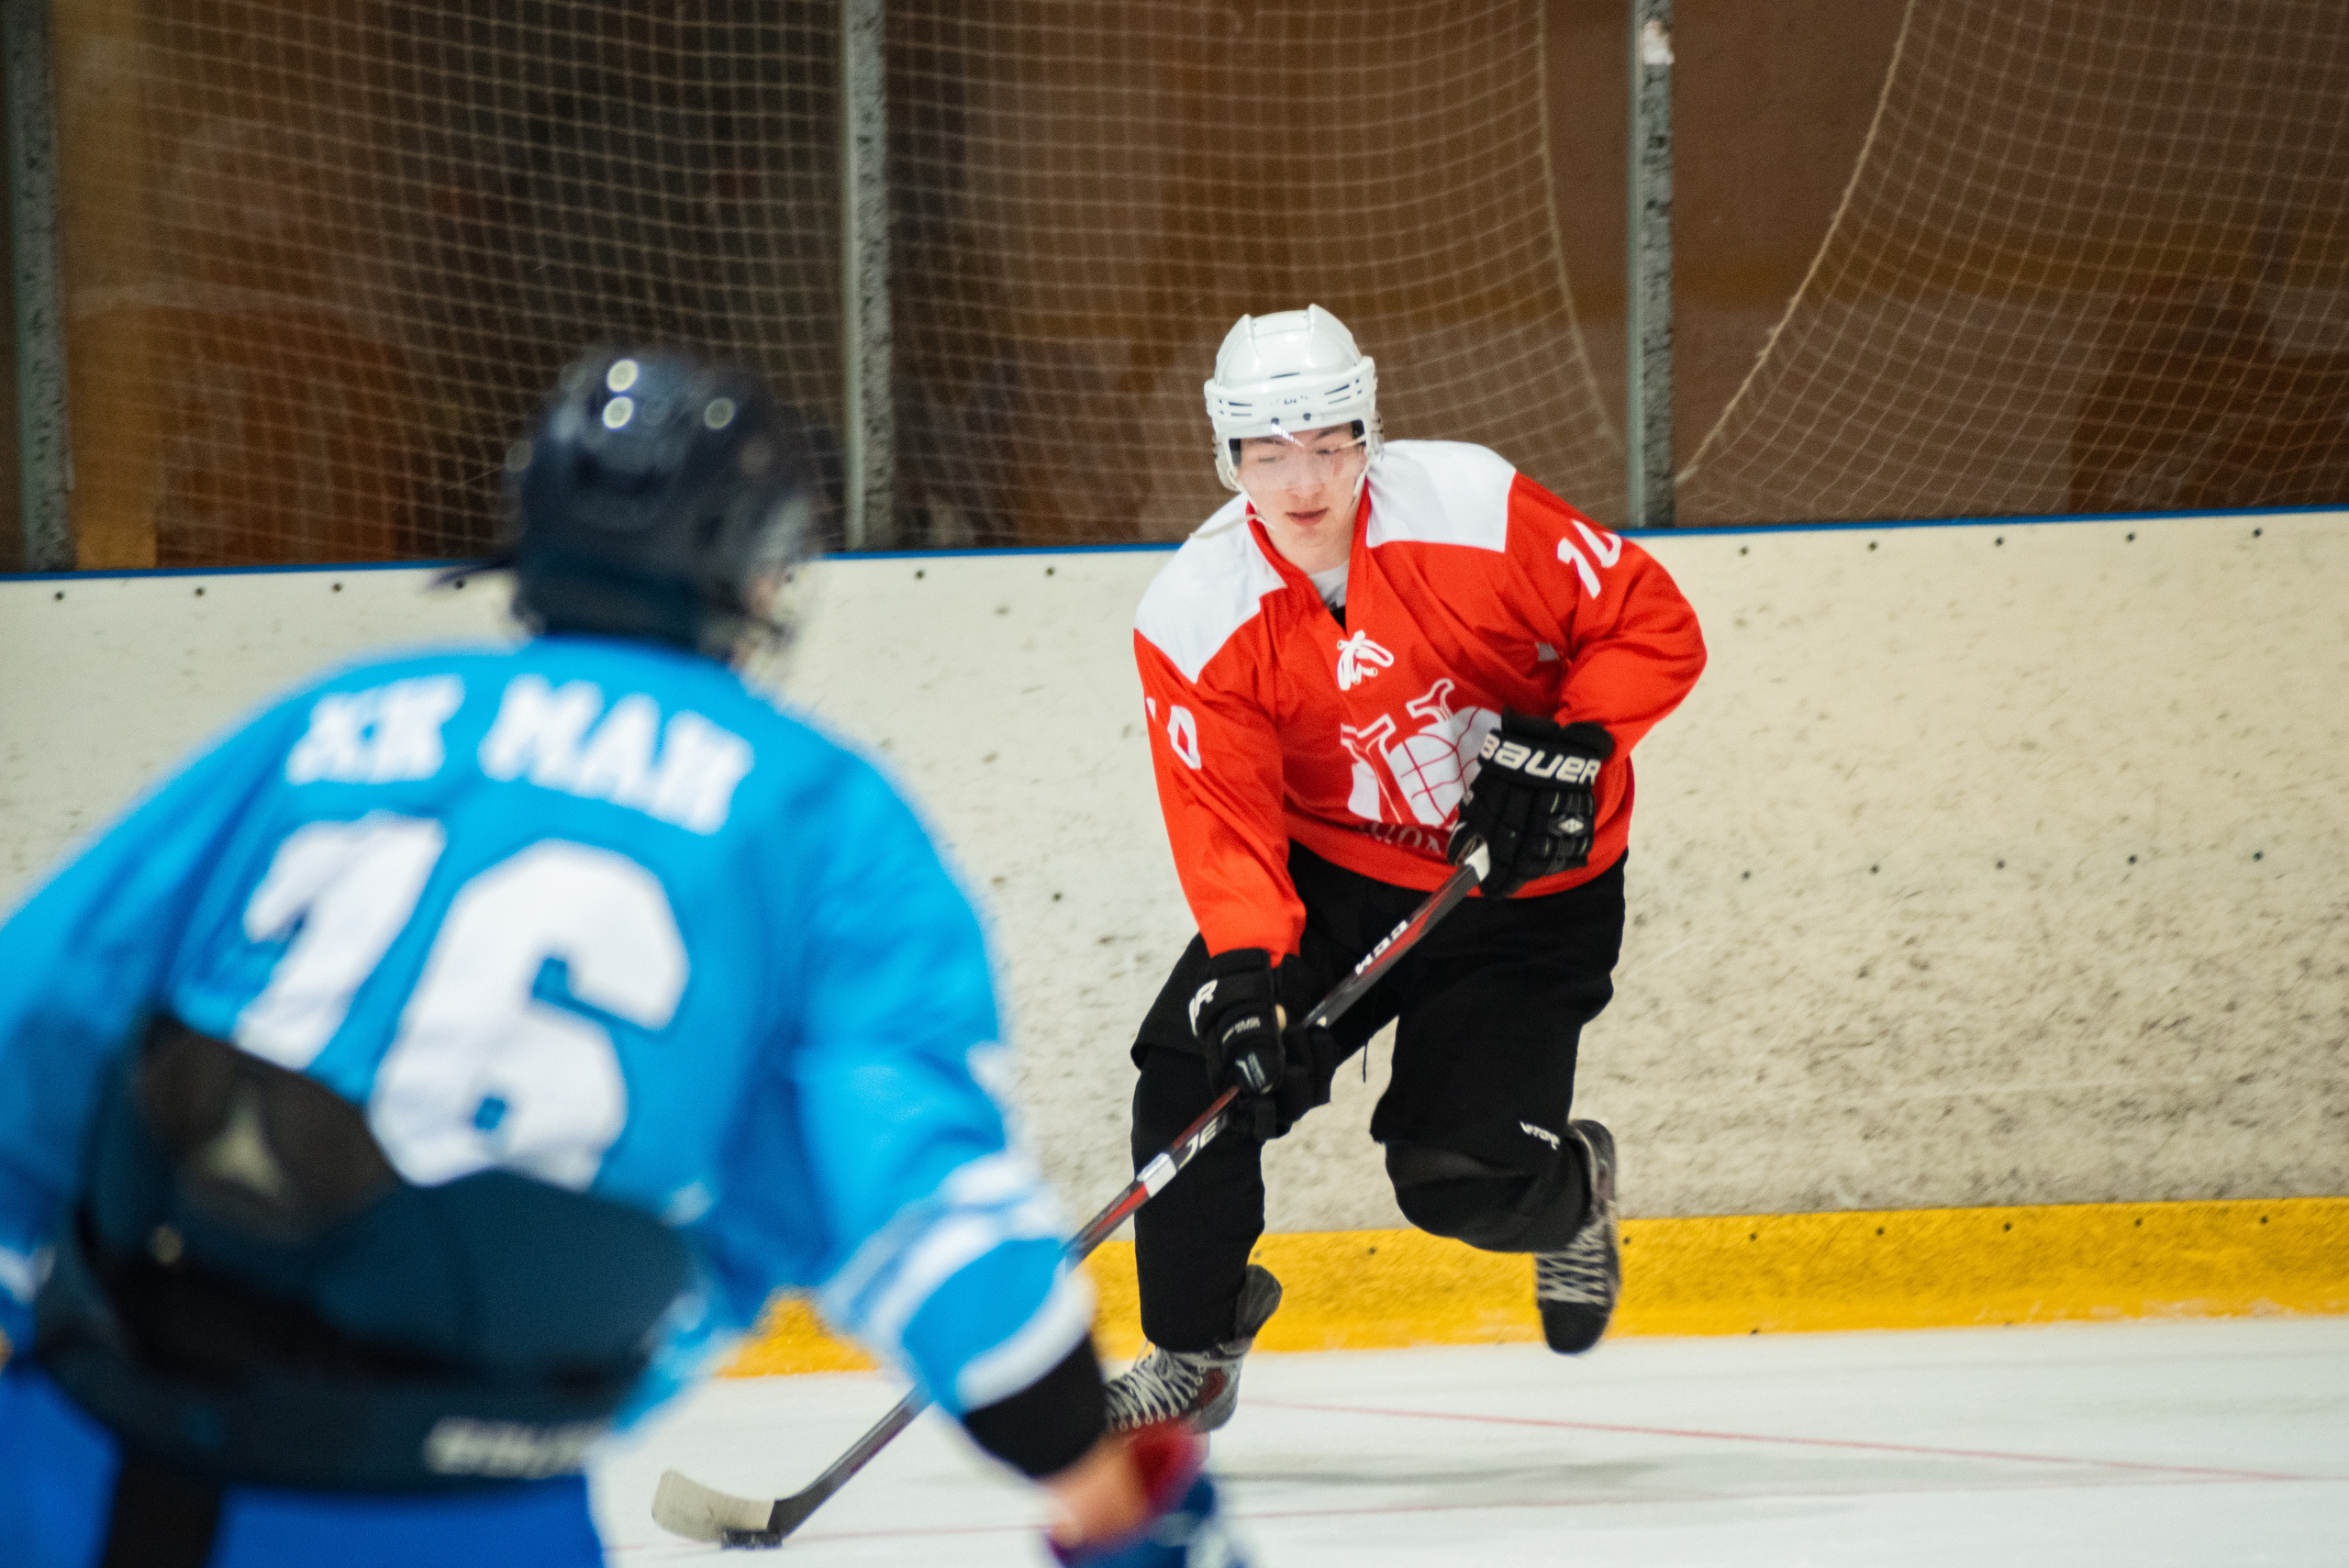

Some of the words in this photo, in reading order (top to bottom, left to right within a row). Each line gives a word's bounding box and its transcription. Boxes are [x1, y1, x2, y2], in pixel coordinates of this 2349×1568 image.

[1556, 518, 1622, 601] 10
[1145, 696, 1202, 771] 0
[231, 808, 691, 1194] 16
